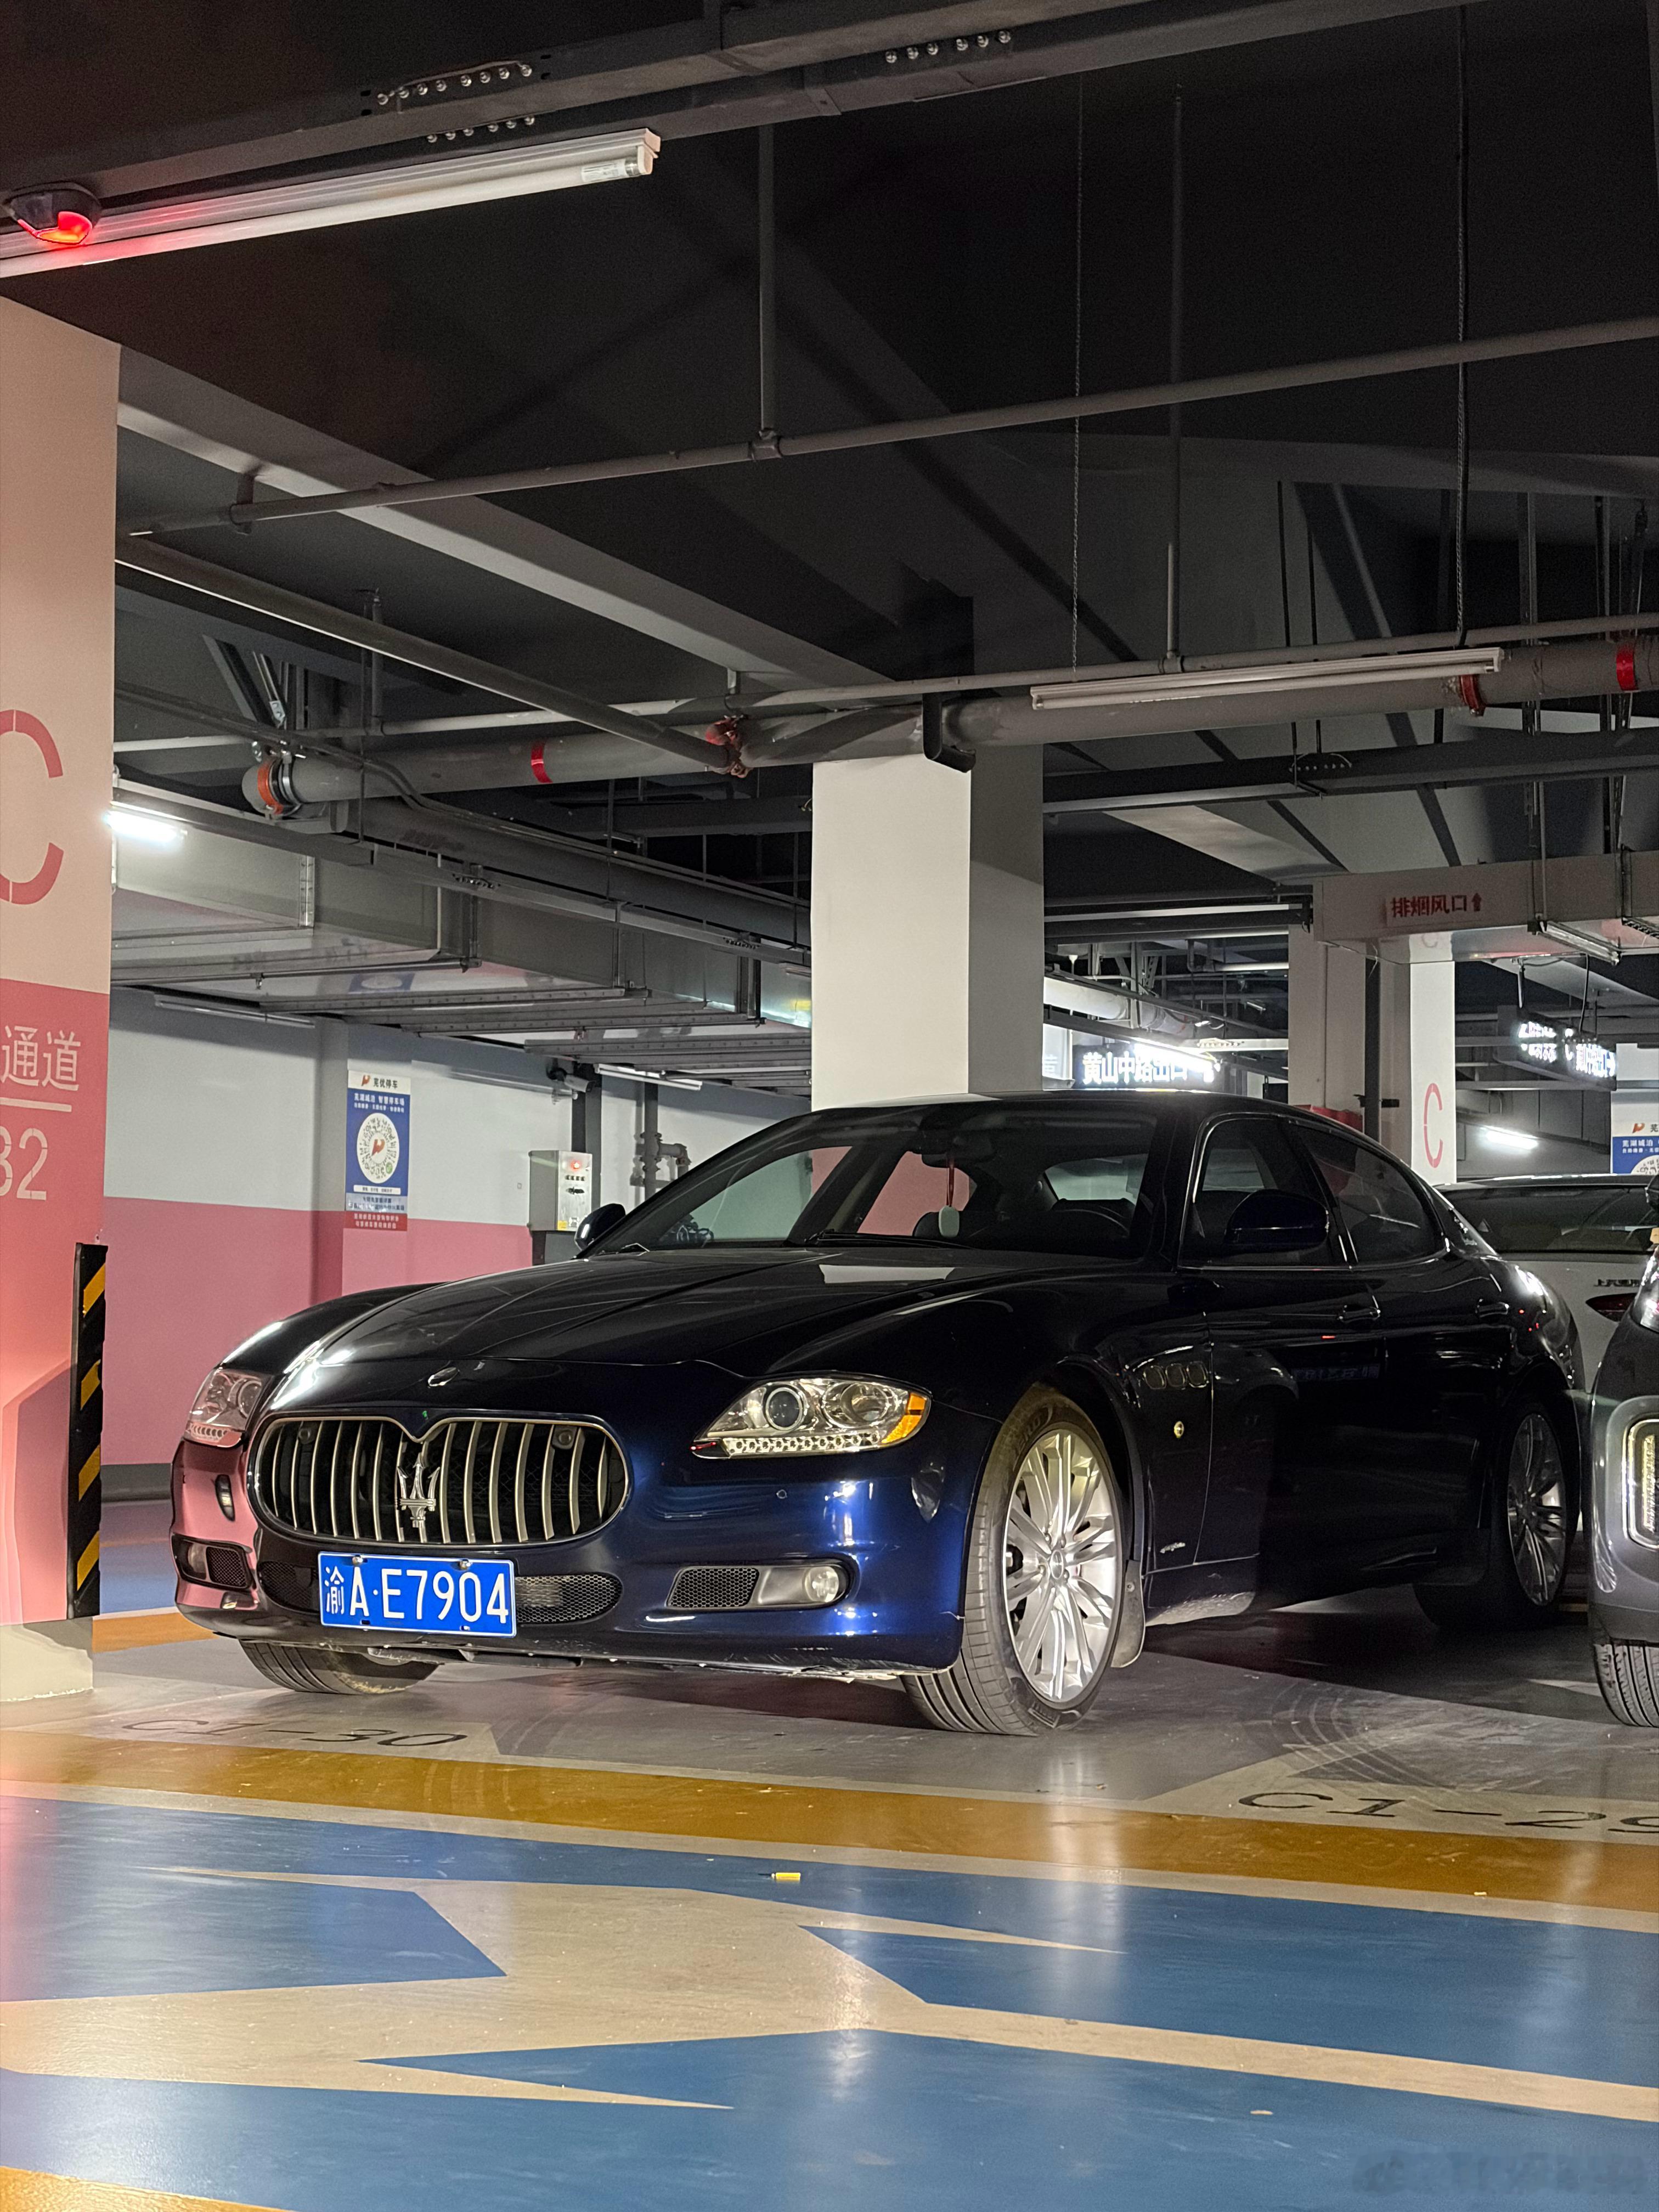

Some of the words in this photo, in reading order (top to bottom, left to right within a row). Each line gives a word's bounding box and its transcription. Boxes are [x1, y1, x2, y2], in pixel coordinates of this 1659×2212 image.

[1390, 894, 1468, 918] 排烟风口
[0, 1025, 81, 1091] 通道
[1082, 1051, 1188, 1085] 黄山中路出口
[1424, 1083, 1443, 1168] C
[122, 1719, 467, 1746] C1-30
